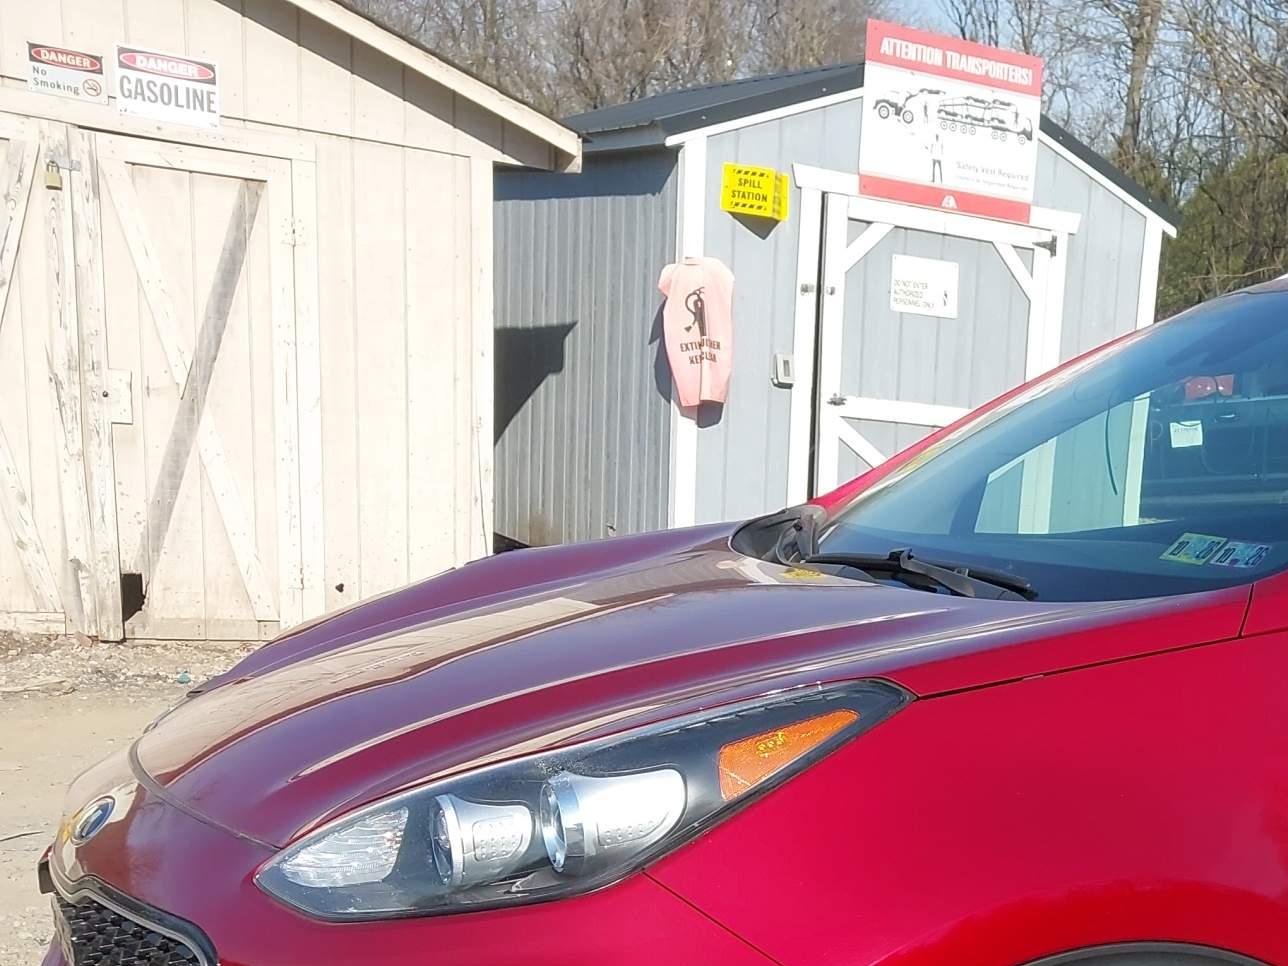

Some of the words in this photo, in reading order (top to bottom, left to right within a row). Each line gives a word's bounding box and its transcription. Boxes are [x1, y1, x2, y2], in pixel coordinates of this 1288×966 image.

[40, 49, 91, 68] DANGER
[135, 55, 199, 77] DANGER
[880, 36, 943, 67] ATTENTION
[945, 50, 1032, 86] TRANSPORTERS!
[32, 66, 47, 76] No
[33, 78, 81, 96] Smoking
[119, 74, 217, 114] GASOLINE
[738, 178, 762, 189] SPILL
[731, 190, 768, 202] STATION
